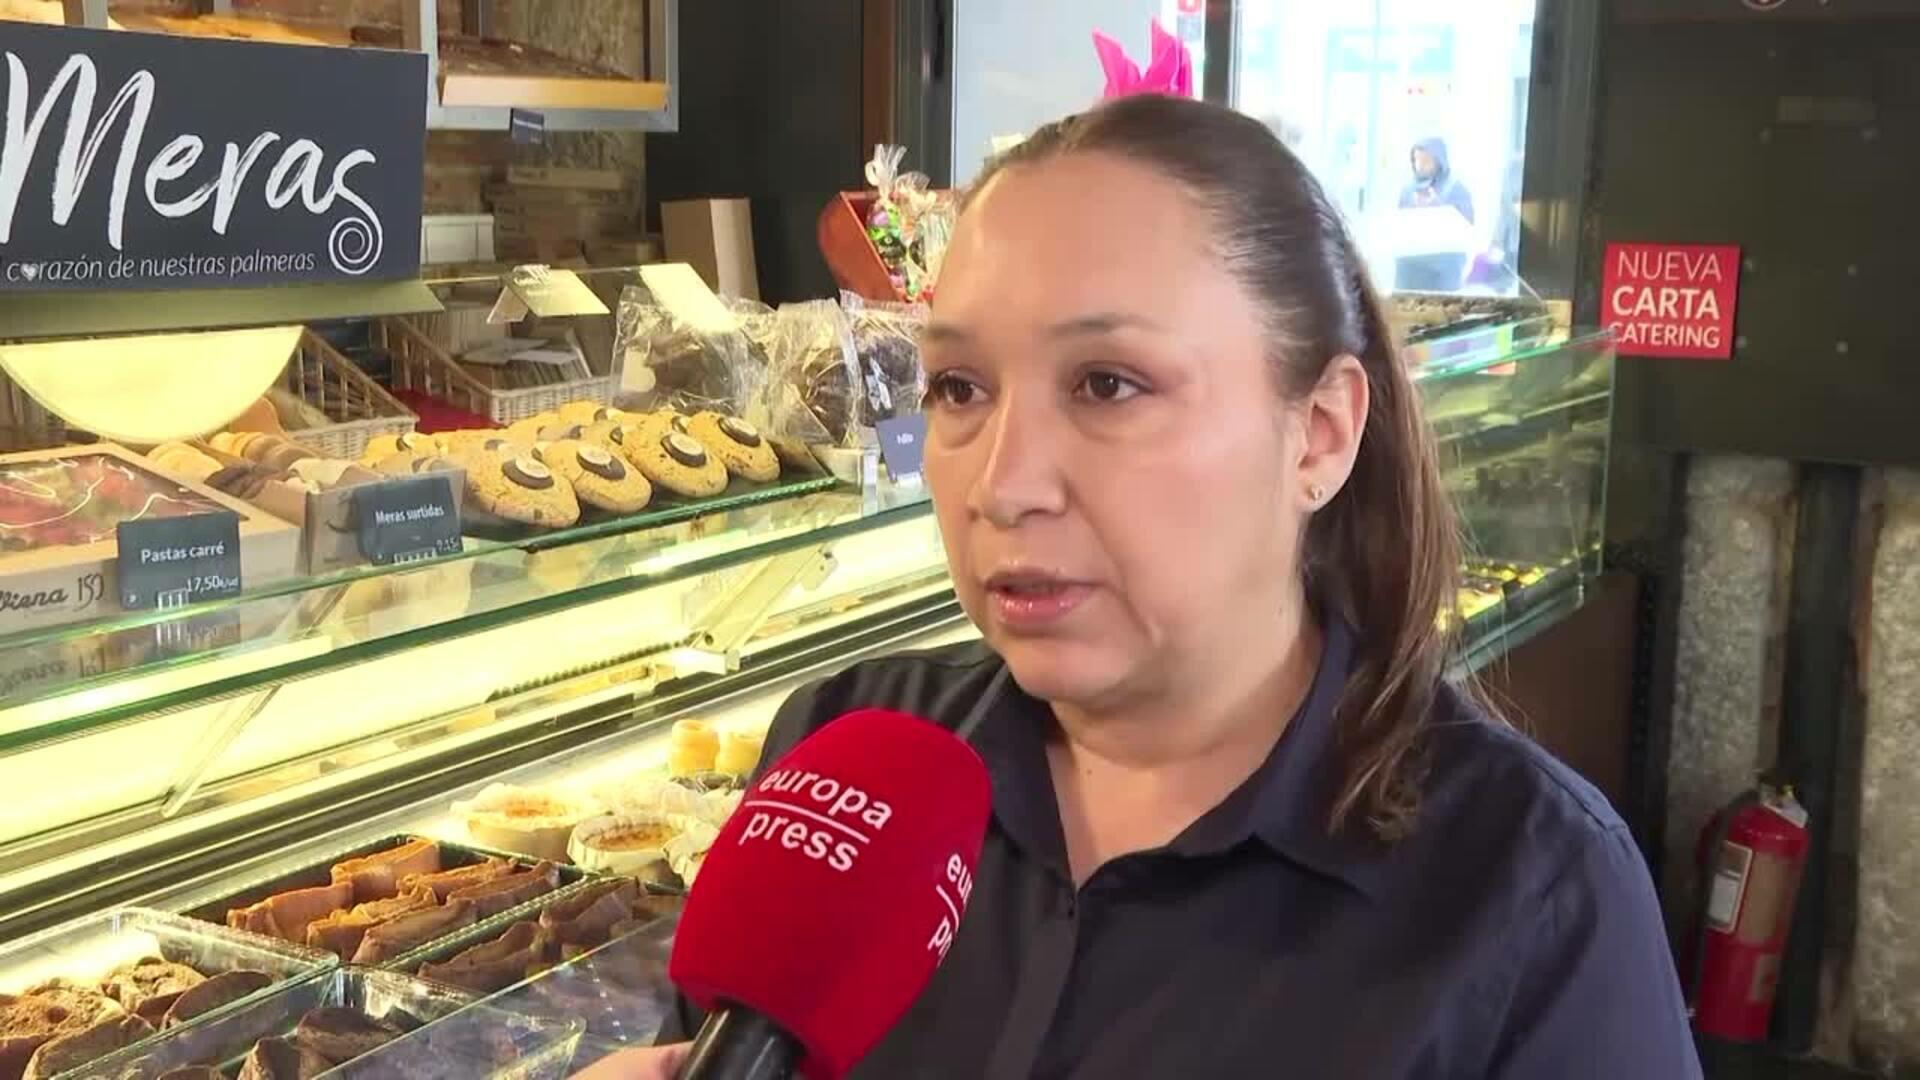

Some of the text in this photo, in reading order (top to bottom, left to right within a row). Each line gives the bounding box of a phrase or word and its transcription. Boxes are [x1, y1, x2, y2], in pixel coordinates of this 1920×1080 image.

[0, 51, 383, 275] Meras
[108, 253, 135, 278] de
[140, 252, 226, 277] nuestras
[229, 248, 315, 280] palmeras
[1618, 251, 1722, 282] NUEVA
[1612, 285, 1720, 320] CARTA
[1608, 321, 1720, 348] CATERING
[141, 540, 225, 565] Pastas carré
[758, 769, 893, 831] europa
[740, 812, 859, 873] press
